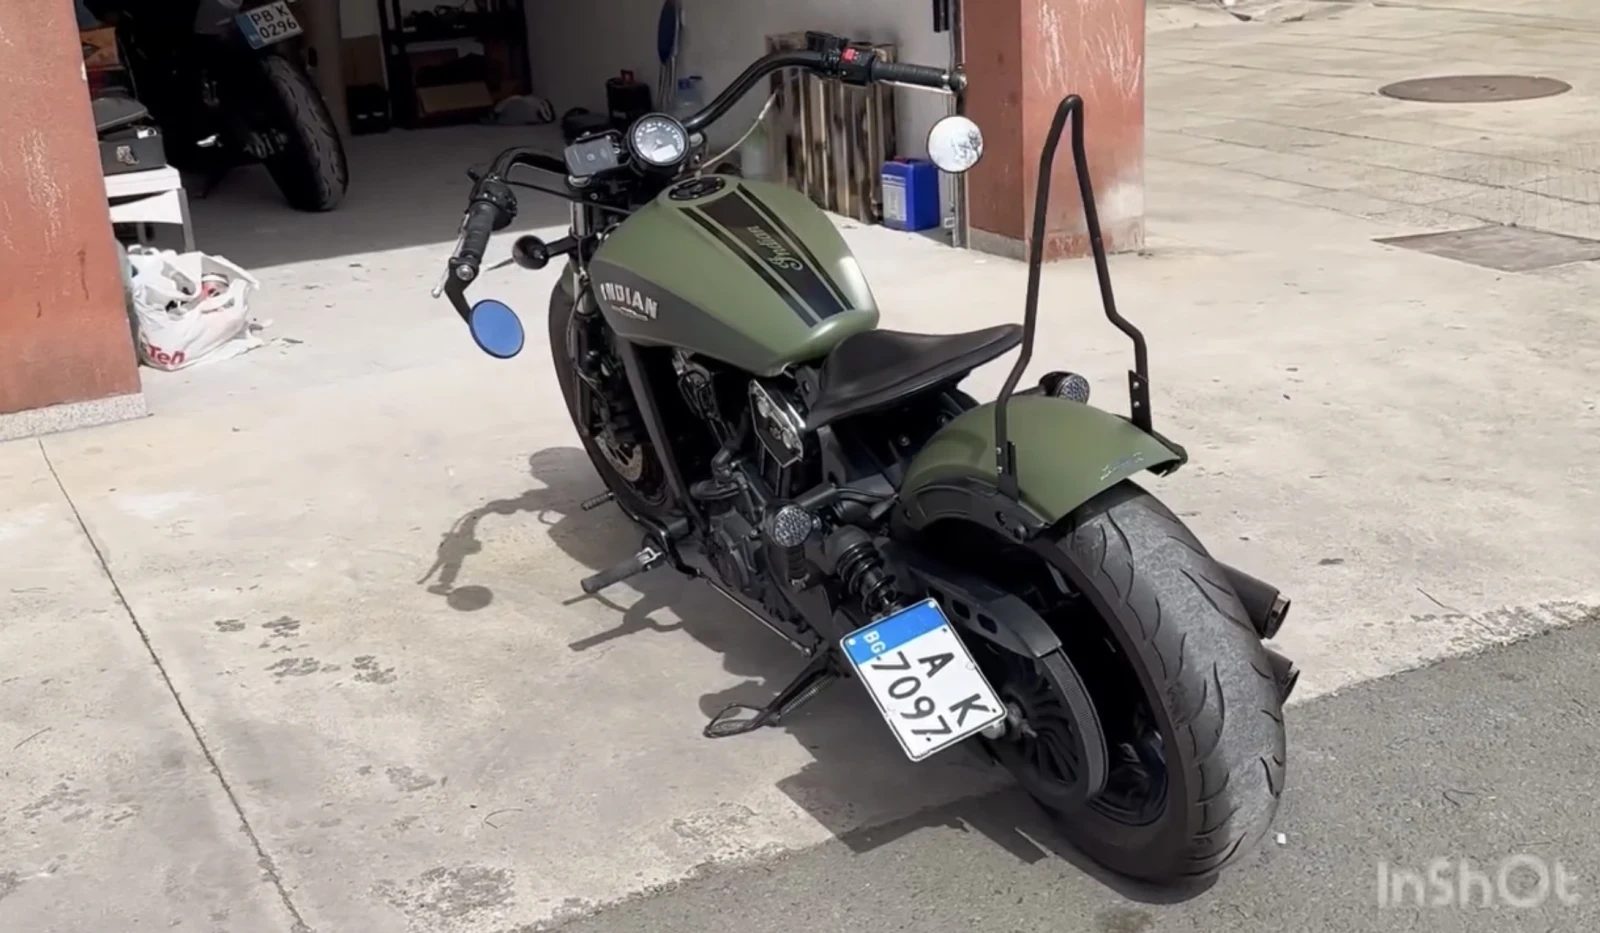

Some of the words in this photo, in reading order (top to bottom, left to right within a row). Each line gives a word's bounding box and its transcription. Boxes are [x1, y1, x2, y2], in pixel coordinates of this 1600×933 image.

[251, 10, 274, 25] PB
[259, 17, 297, 38] 0296
[600, 282, 658, 320] INDIAN
[863, 630, 887, 654] BG
[871, 650, 953, 736] 7097
[917, 652, 955, 679] A
[948, 693, 991, 728] K
